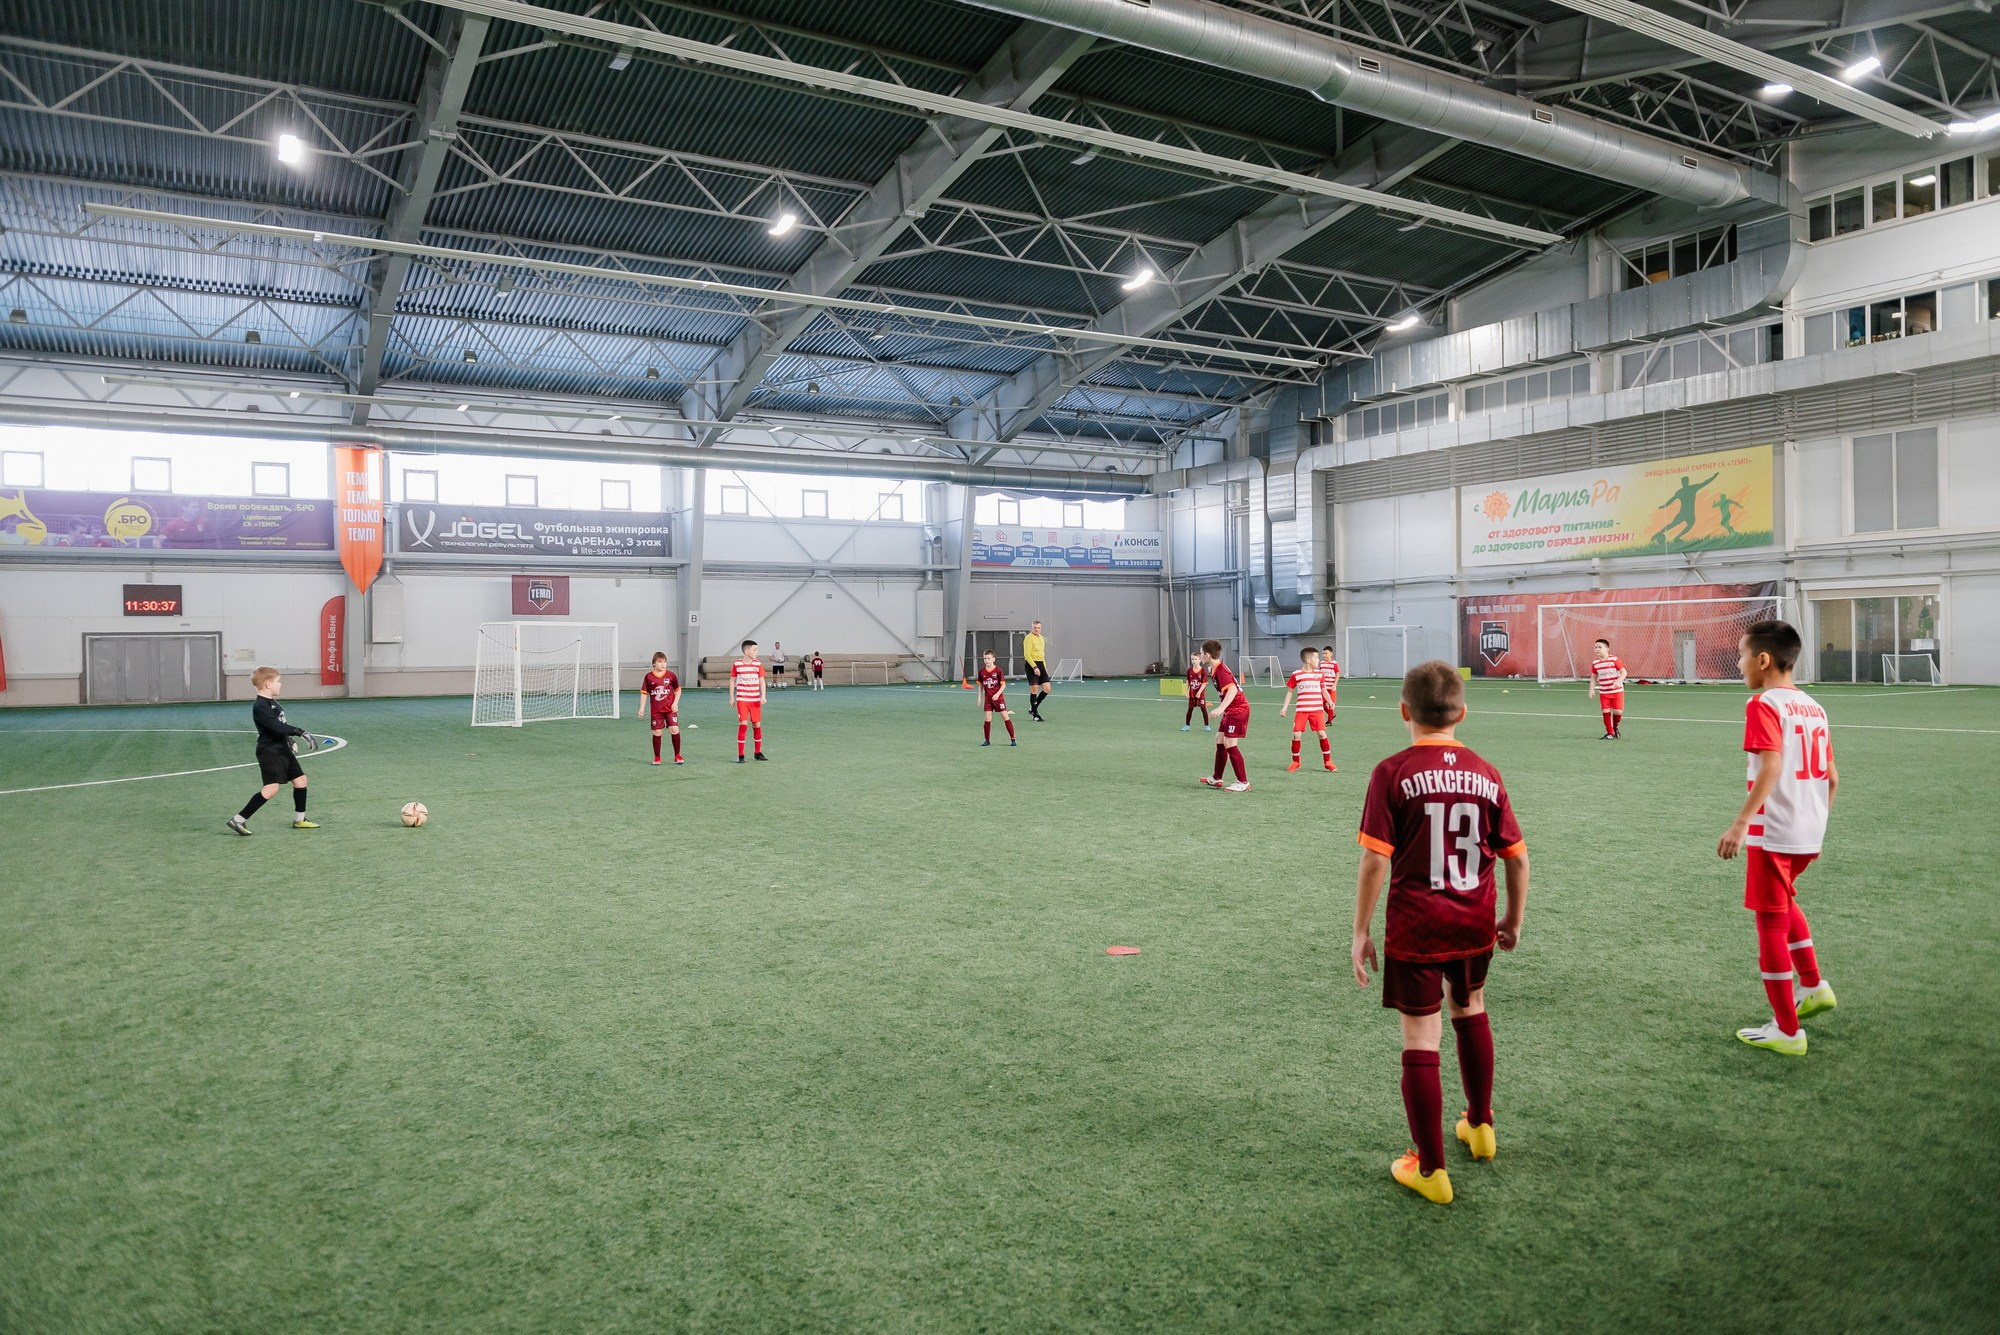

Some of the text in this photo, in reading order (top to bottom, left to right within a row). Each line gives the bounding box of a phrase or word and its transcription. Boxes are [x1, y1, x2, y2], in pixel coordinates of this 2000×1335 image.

[1644, 457, 1752, 477] ОФИЦИАЛЬНЫЙ ПАРТНЕР СК «ТЕМП»
[207, 502, 237, 512] Время
[239, 503, 292, 513] побеждать,
[342, 508, 380, 523] ТОЛЬКО
[348, 527, 376, 541] ТЕМП!
[533, 521, 669, 535] Футбольная экипировка
[1488, 530, 1501, 539] ОТ
[1502, 524, 1562, 538] ЗДОРОВОГО
[1562, 519, 1614, 533] ПИТАНИЯ
[539, 535, 662, 548] ТРЦ «АРЕНА», 3 этаж
[1124, 538, 1159, 547] КОНСИБ
[1472, 545, 1487, 554] ДО
[1487, 540, 1545, 553] ЗДОРОВОГО
[1546, 535, 1586, 548] ОБРАЗА
[1587, 532, 1630, 544] ЖИЗНИ
[580, 547, 632, 556] lite-sports.ru
[531, 588, 551, 599] ТЕМП
[125, 601, 177, 611] 11:30:37
[327, 614, 338, 672] Альфа Банк
[1482, 633, 1508, 649] ТЕМП
[1794, 725, 1830, 780] 10
[1424, 802, 1481, 891] 13
